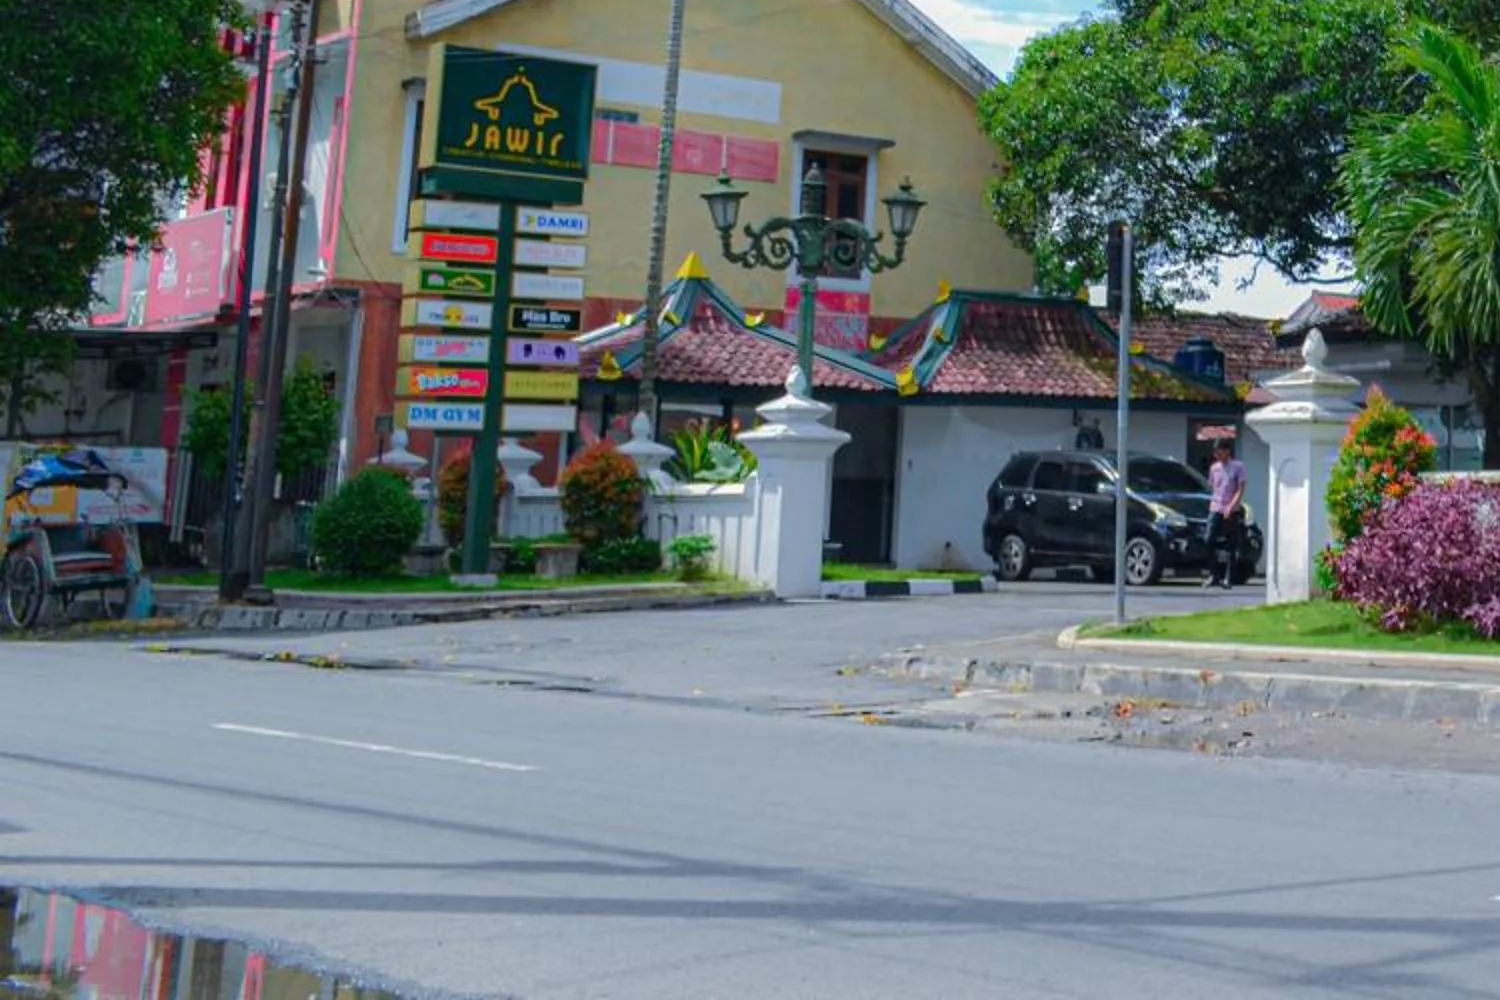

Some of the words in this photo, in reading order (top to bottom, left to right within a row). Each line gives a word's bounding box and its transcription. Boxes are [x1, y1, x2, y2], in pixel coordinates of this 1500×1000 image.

[537, 215, 583, 229] DAMRI
[411, 407, 438, 422] DM
[443, 407, 481, 422] GYM
